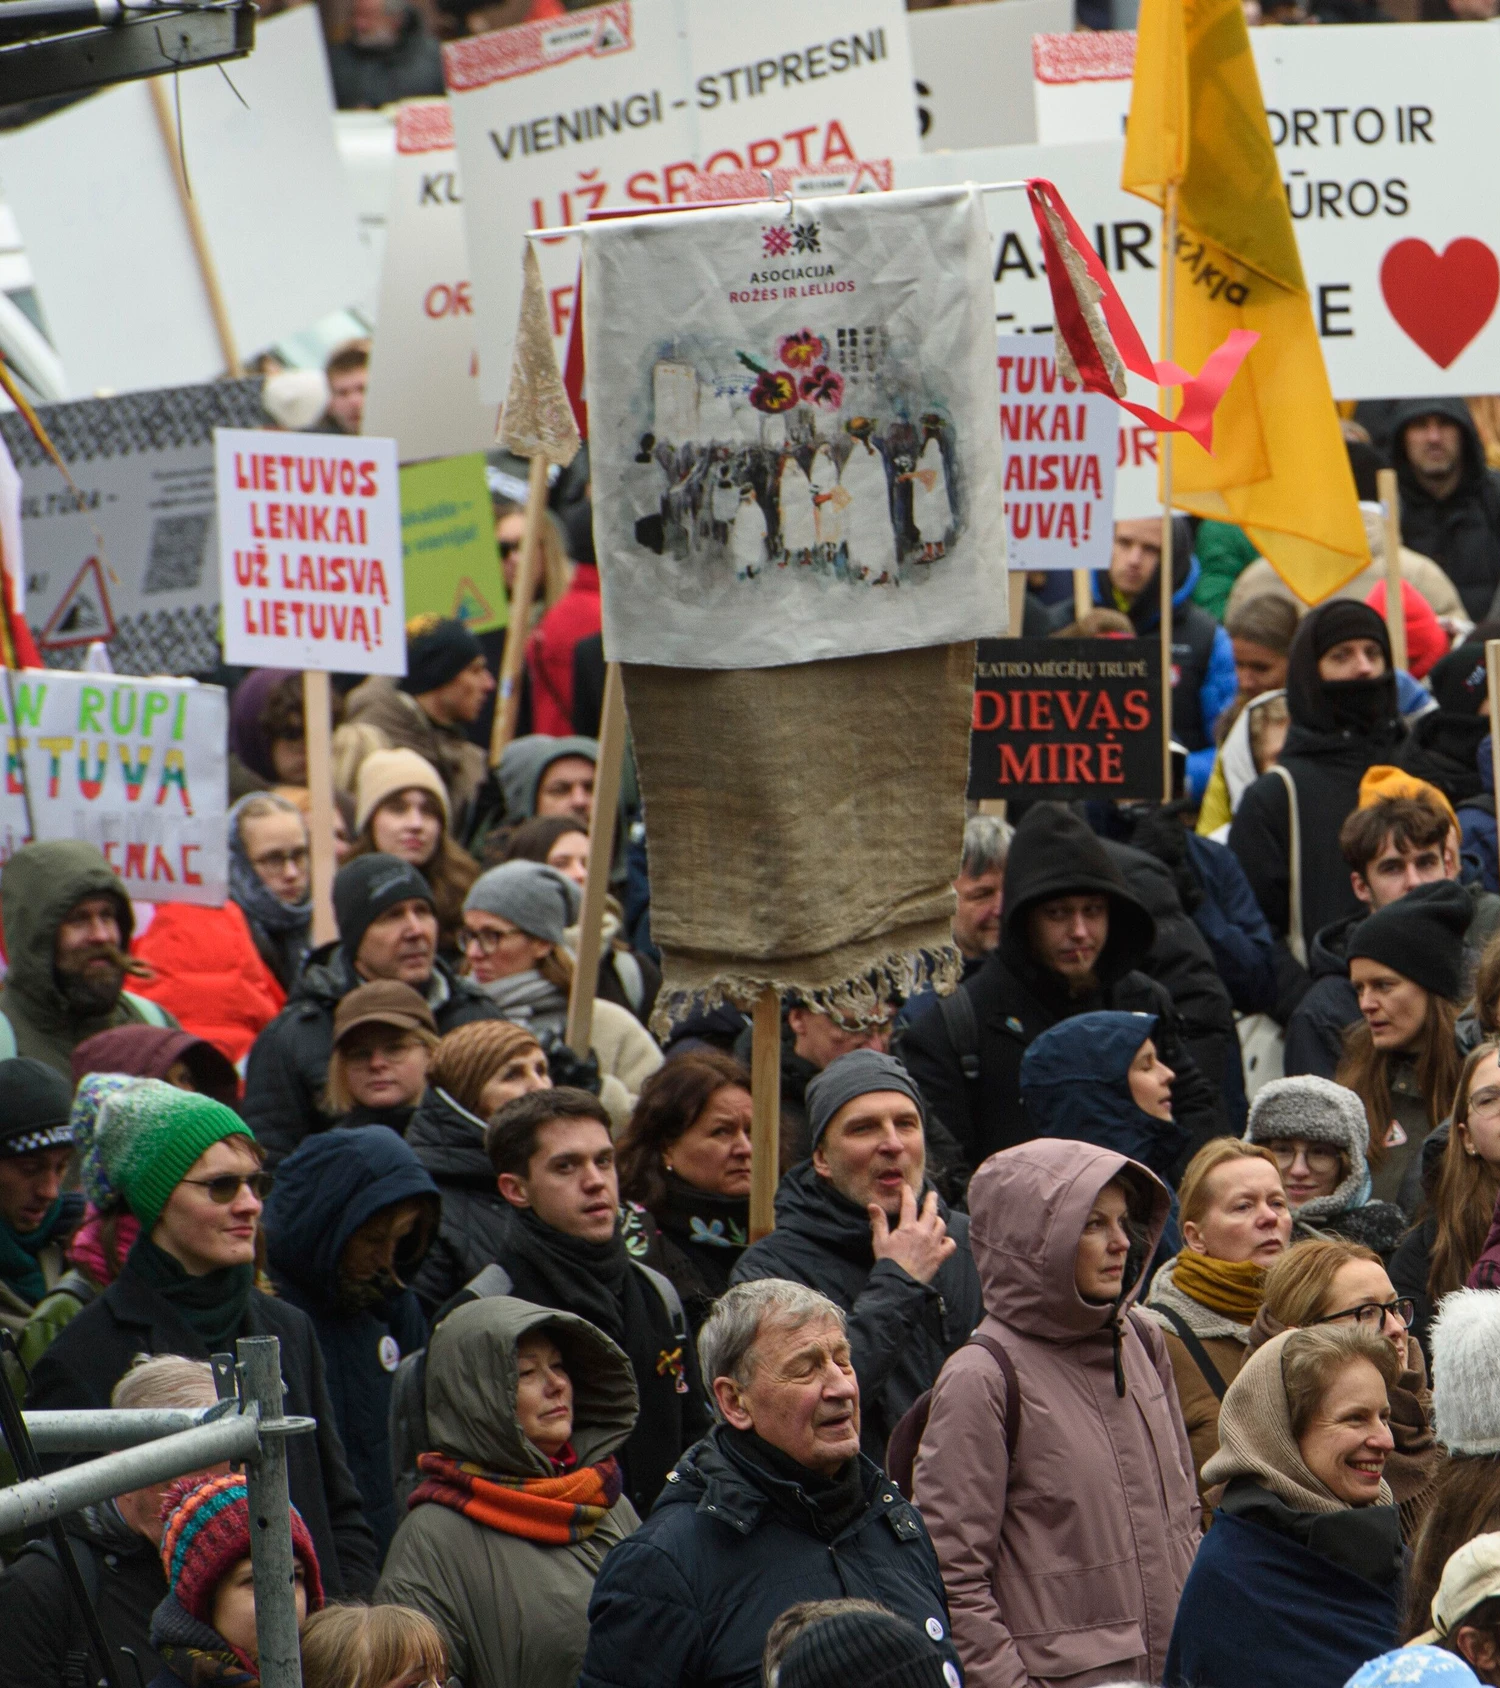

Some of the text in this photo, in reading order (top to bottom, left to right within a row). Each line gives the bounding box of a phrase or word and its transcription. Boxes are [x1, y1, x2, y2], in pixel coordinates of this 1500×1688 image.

[489, 90, 663, 161] VIENINGI
[697, 27, 888, 110] STIPRESNI
[1396, 105, 1435, 145] IR
[532, 168, 608, 244] UŽ
[1284, 169, 1411, 220] ŪROS
[1095, 219, 1156, 272] IR
[728, 280, 856, 304] ROŽĖS IR LELIJOS
[750, 264, 835, 284] ASOCIACIJA
[234, 452, 378, 498] LIETUVOS
[250, 501, 368, 545] LENKAI
[1004, 502, 1093, 549] UVĄ!
[234, 543, 390, 606] UŽ LAISVĄ
[244, 598, 383, 652] LIETUVĄ!
[78, 683, 188, 741] RŪPI
[972, 688, 1152, 731] DIEVAS
[997, 732, 1126, 784] MIRĖ
